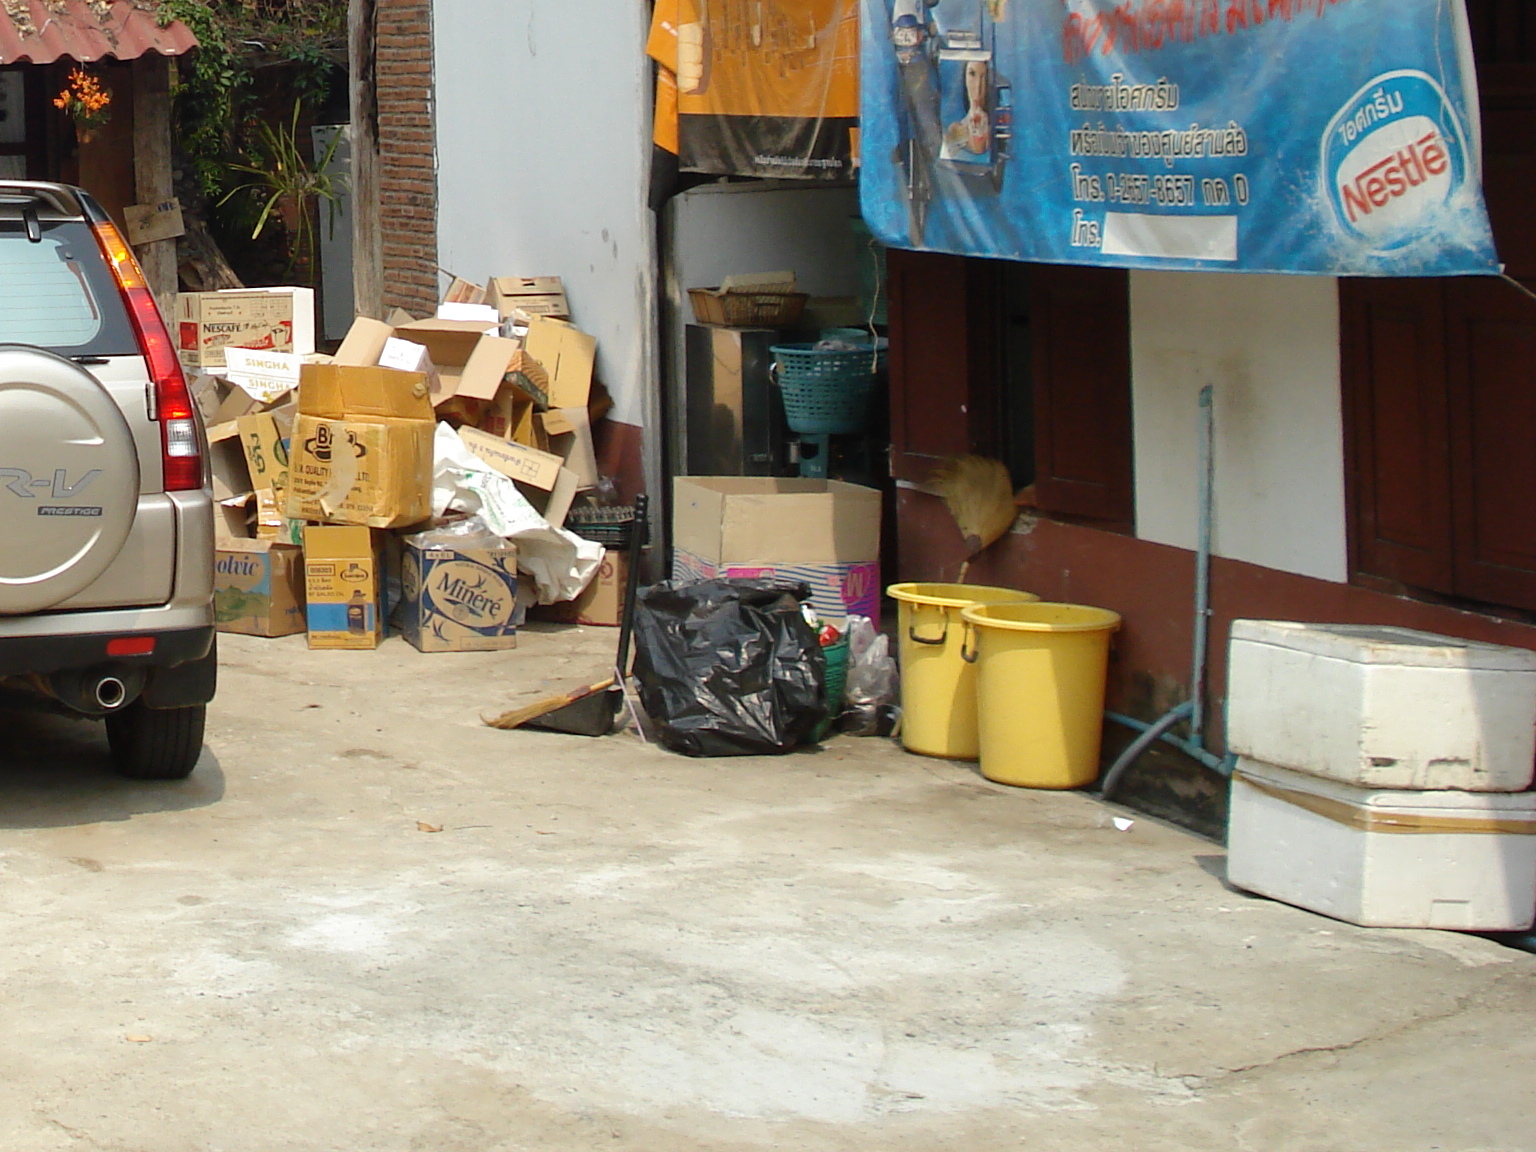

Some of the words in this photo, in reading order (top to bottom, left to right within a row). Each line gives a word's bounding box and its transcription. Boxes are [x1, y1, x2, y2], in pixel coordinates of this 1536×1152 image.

[1337, 86, 1404, 147] ไอศกรีม
[1070, 163, 1105, 202] โทร.
[1201, 177, 1230, 206] กด
[1233, 172, 1250, 205] 0
[1070, 208, 1102, 247] โทร.
[244, 357, 291, 372] SINGHA
[40, 507, 101, 516] PRESTIGE
[216, 554, 260, 578] olvic
[435, 571, 505, 618] Minéré
